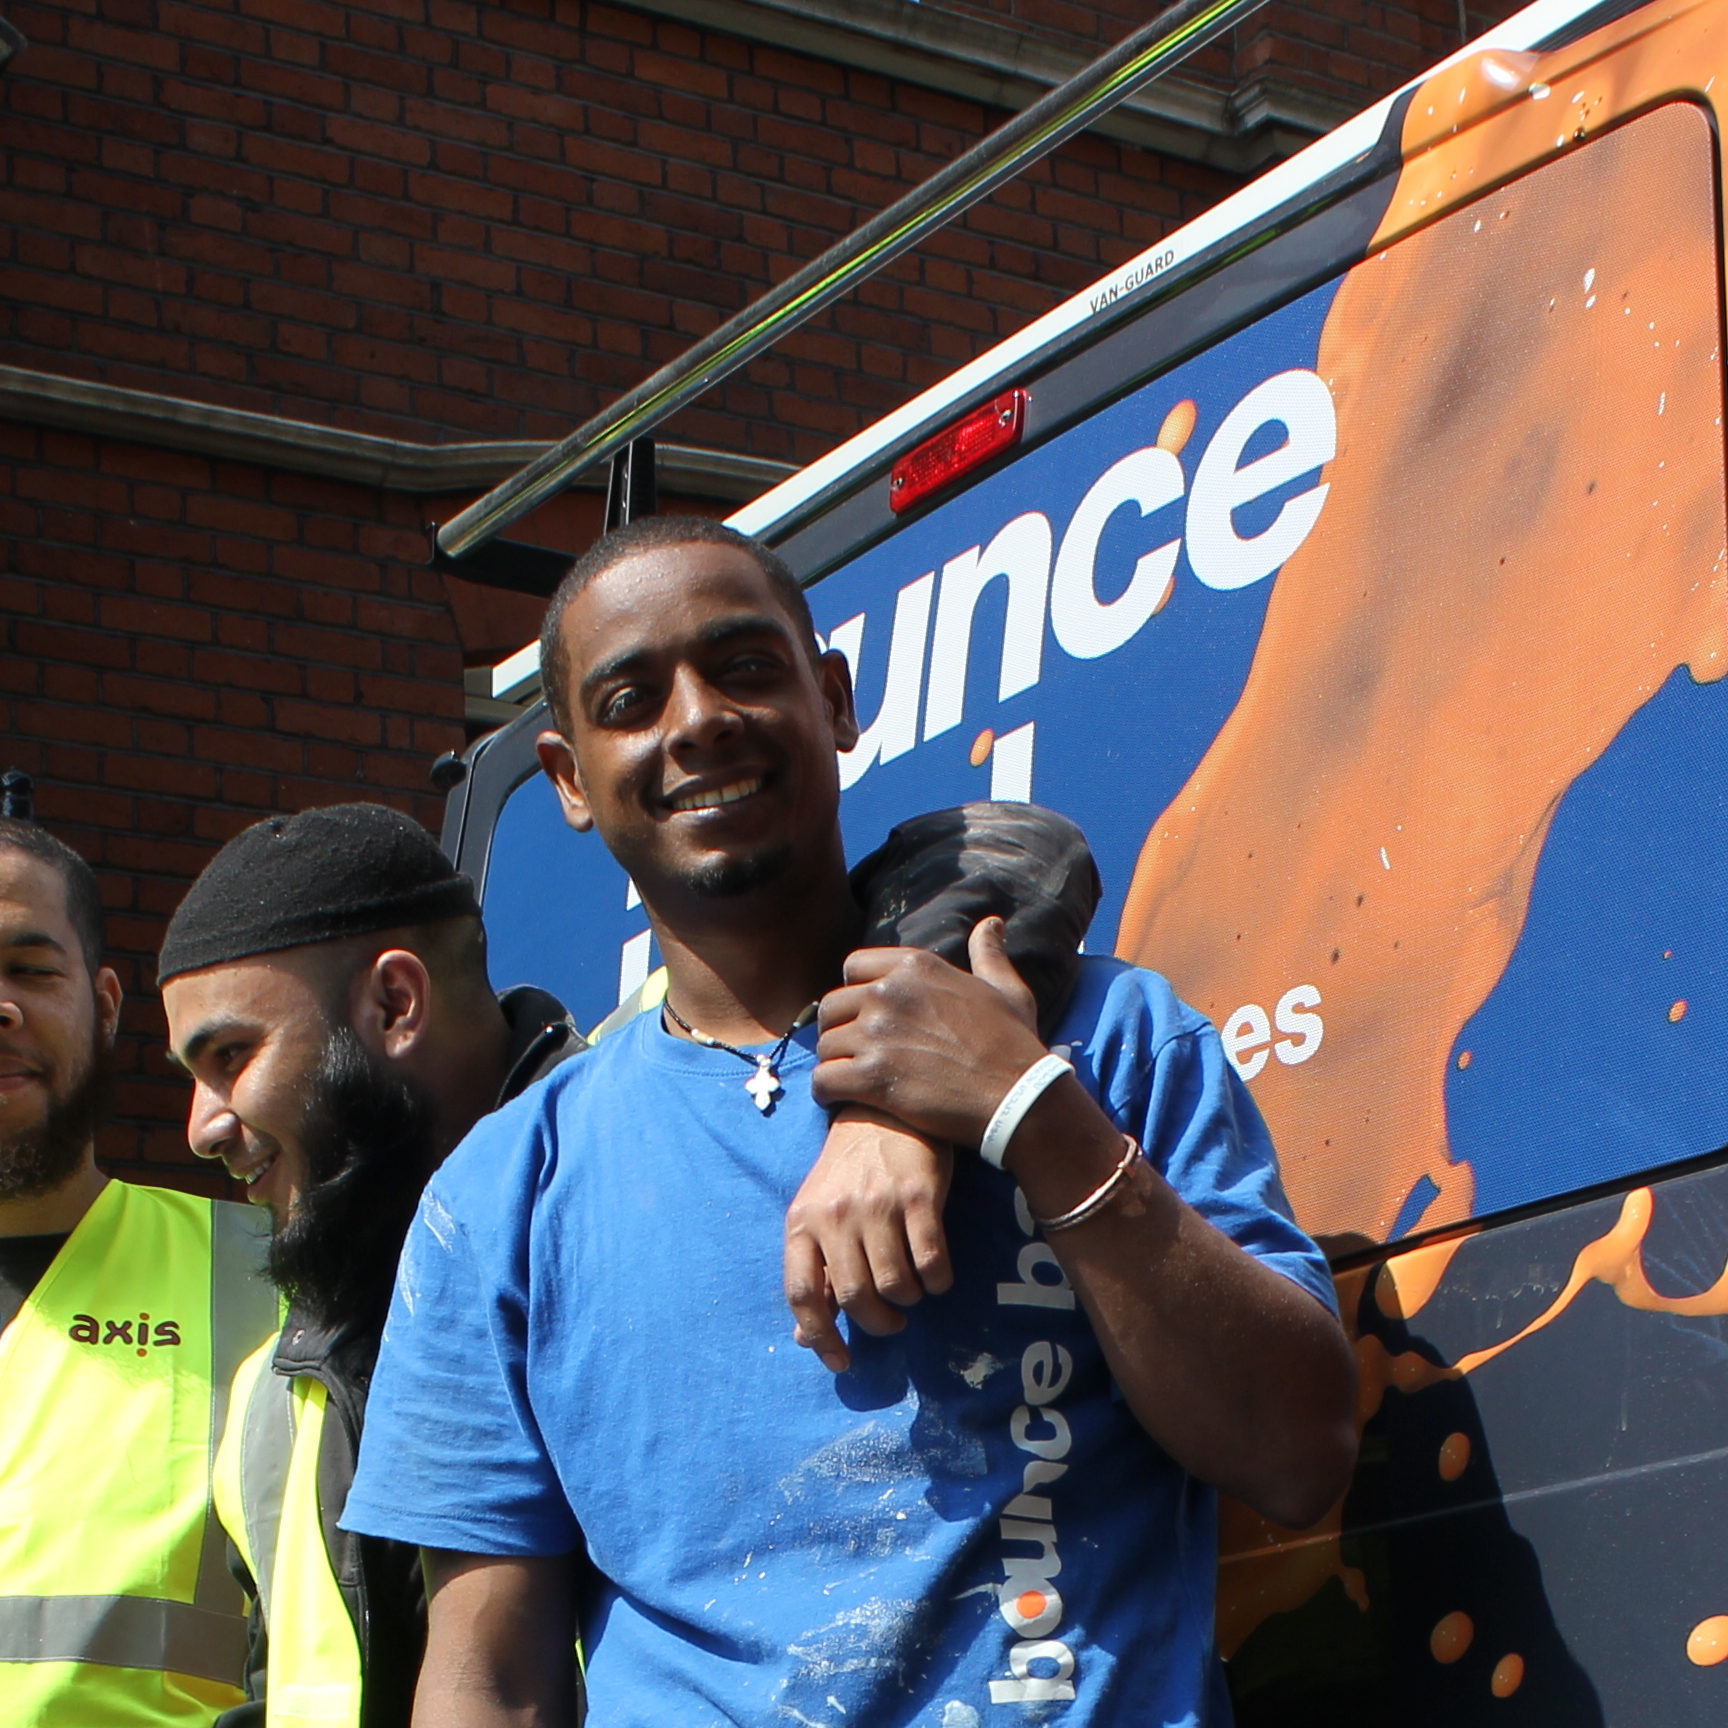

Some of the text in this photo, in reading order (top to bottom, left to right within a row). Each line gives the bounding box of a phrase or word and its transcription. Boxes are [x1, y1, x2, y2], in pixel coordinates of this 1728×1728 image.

[1090, 249, 1175, 315] VAN-GUARD
[813, 368, 1337, 793] unce
[69, 1312, 181, 1357] axis
[988, 1341, 1076, 1705] bounce
